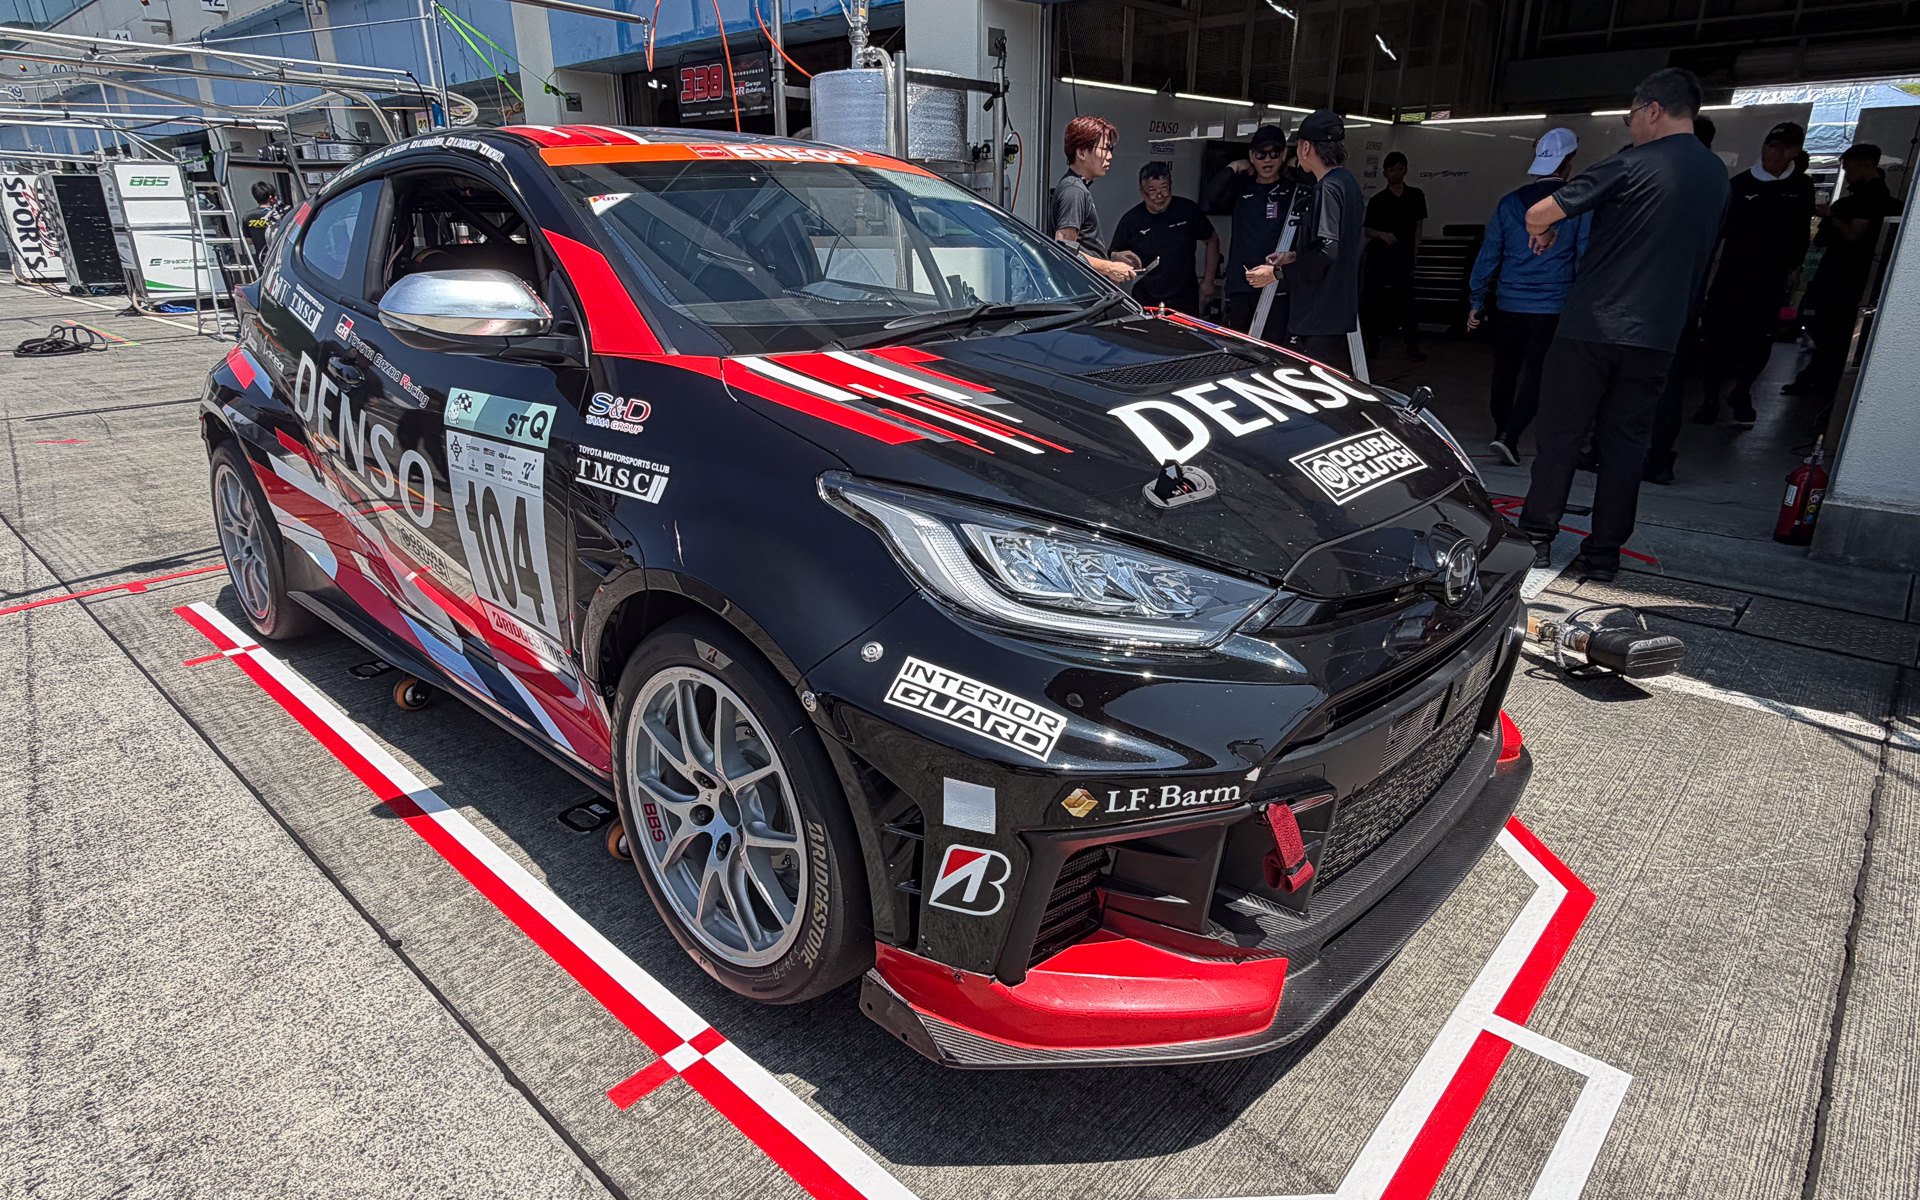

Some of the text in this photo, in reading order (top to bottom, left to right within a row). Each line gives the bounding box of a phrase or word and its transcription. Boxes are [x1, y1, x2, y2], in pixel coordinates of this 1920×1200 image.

[681, 64, 723, 104] 338
[1149, 121, 1179, 134] DENSO
[726, 145, 859, 164] ENEOS
[3, 176, 48, 270] SPORTS
[347, 330, 376, 362] TOYOTA
[400, 373, 430, 409] Racing
[586, 415, 644, 435] TAMA GROUP
[588, 392, 652, 423] S&D
[294, 349, 435, 529] DENSO
[1331, 435, 1402, 466] OGURA
[576, 457, 651, 494] TMSC
[579, 445, 670, 474] TOYOTA MOTORSPORTS CLUB
[1346, 448, 1417, 485] CLUTCH
[464, 480, 547, 628] 104
[492, 610, 566, 667] BRIDGESTONE
[892, 680, 1050, 748] GUARD
[903, 661, 1061, 734] INTERIOR
[1104, 784, 1241, 814] LF.Barm
[643, 802, 667, 843] BBS
[801, 819, 830, 970] BRIDGESTONE
